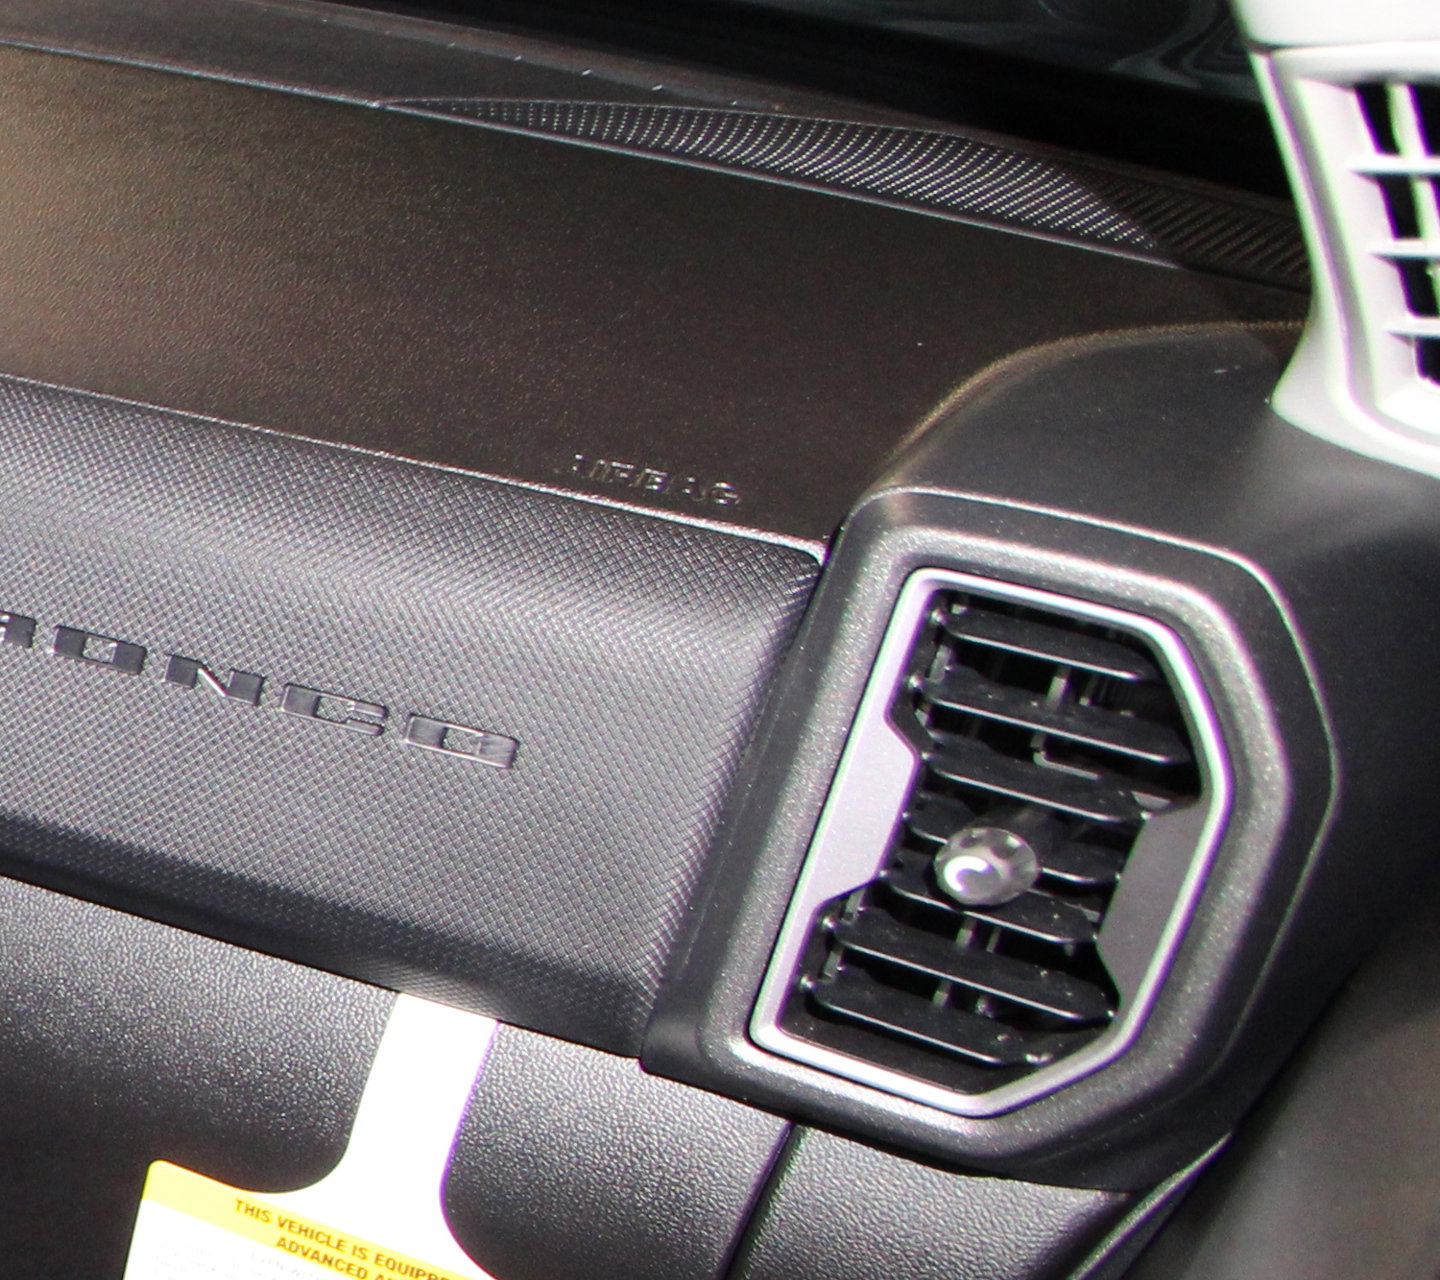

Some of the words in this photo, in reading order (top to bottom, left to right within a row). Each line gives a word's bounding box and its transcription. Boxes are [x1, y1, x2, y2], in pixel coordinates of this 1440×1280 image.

[235, 1199, 272, 1224] THIS
[277, 1215, 347, 1252] VEHICLE
[352, 1245, 369, 1261] IS
[275, 1237, 369, 1280] ADVANCED
